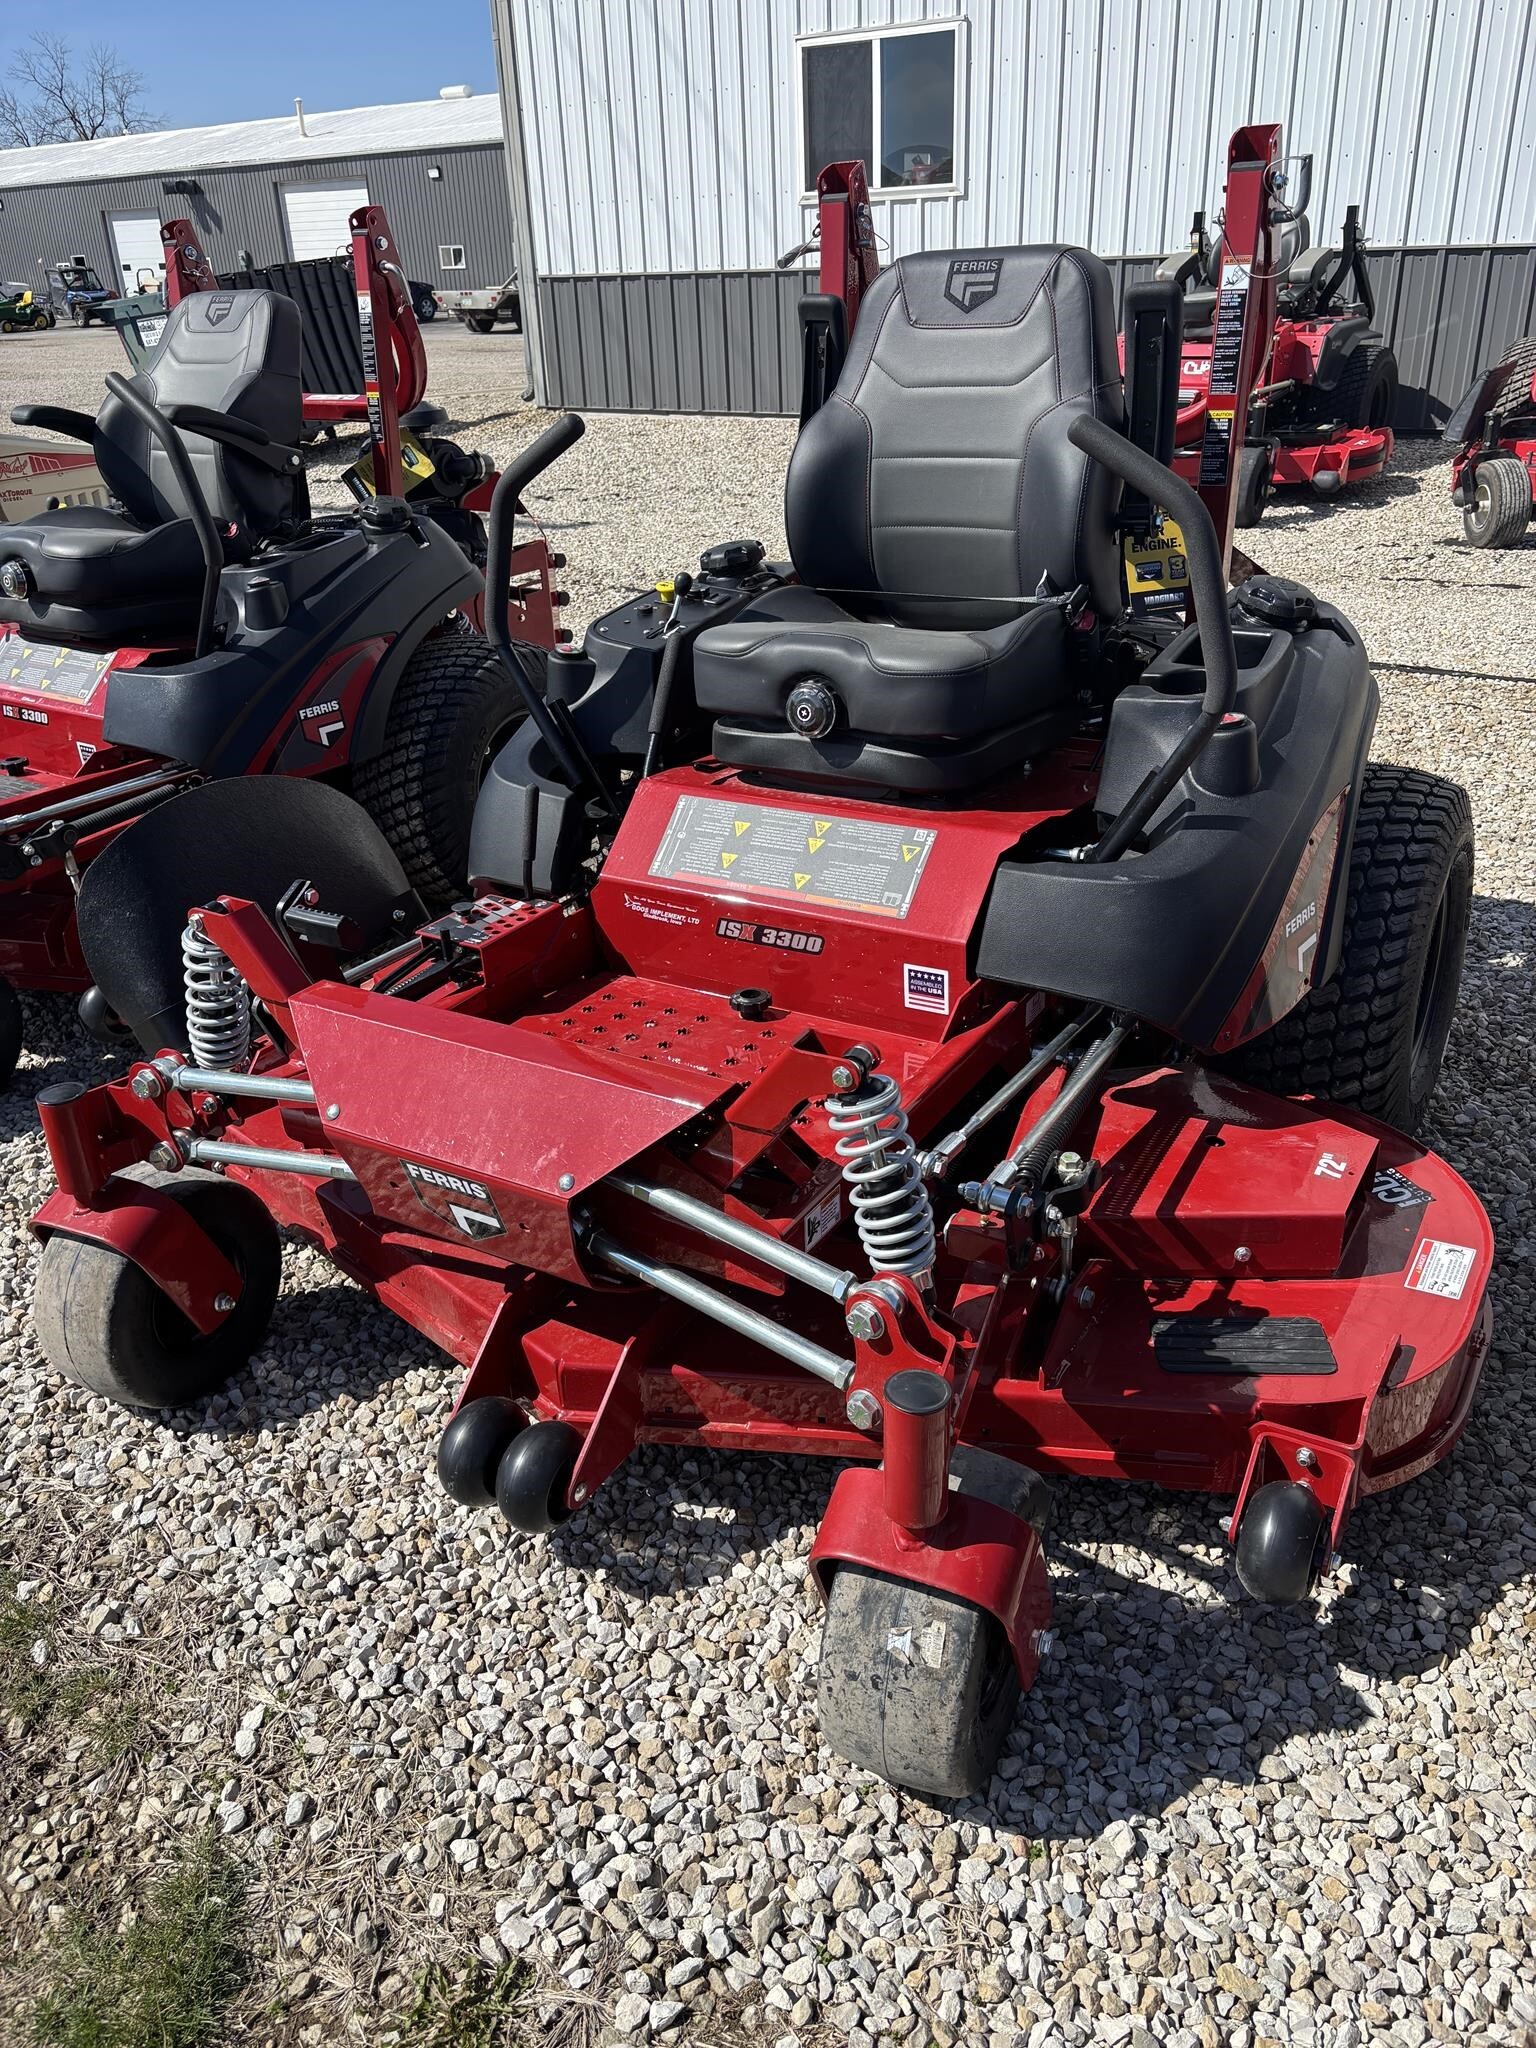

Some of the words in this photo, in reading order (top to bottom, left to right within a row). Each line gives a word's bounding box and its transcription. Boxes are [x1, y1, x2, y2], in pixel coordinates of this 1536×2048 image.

[953, 260, 999, 272] FERRIS
[1131, 537, 1182, 553] ENGINE.
[21, 708, 48, 725] 3300
[299, 700, 340, 721] FERRIS
[631, 904, 649, 913] GOOS
[650, 908, 687, 923] IMPLEMENT,
[687, 916, 700, 925] LTD
[1284, 902, 1317, 939] FERRIS
[717, 919, 757, 941] ISX
[762, 928, 823, 954] 3300
[910, 979, 943, 989] ASSEMBLED
[927, 988, 943, 996] USA
[1313, 1152, 1348, 1179] 72"
[406, 1161, 488, 1202] FERRIS
[1387, 1167, 1434, 1202] CUTTING
